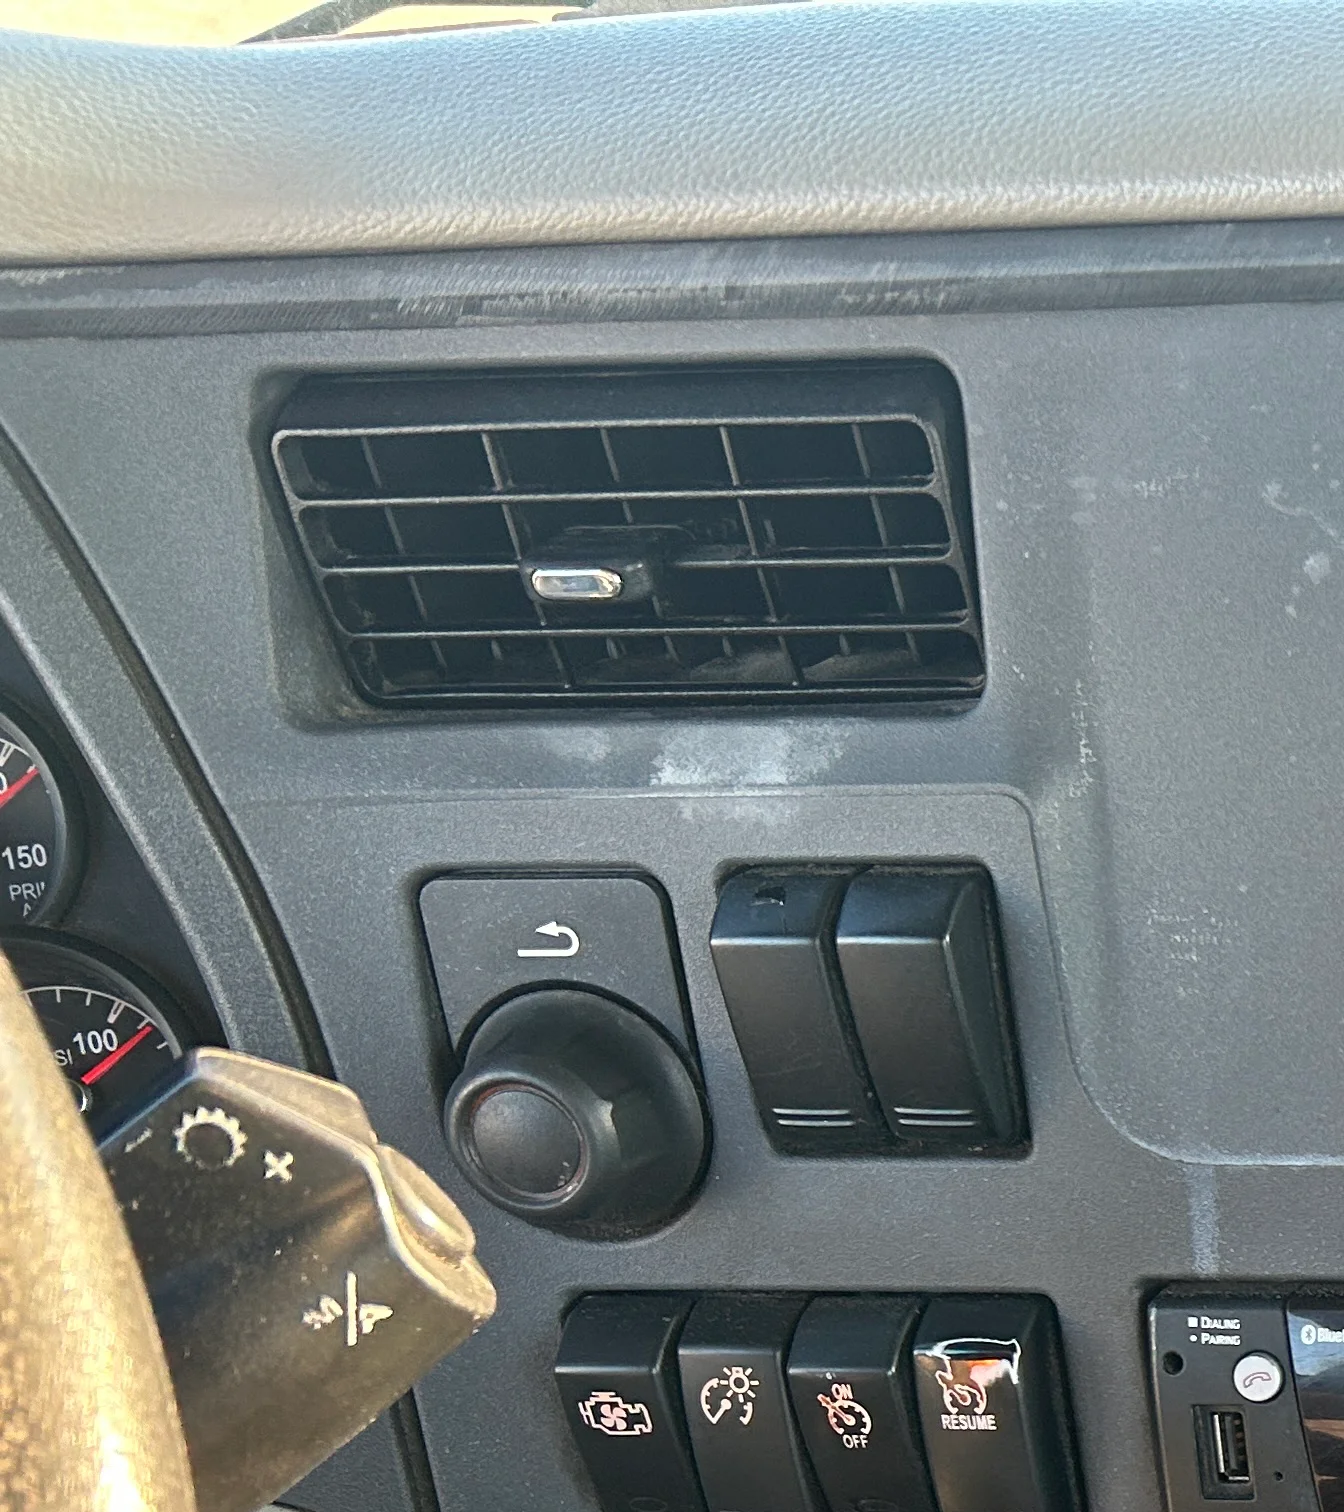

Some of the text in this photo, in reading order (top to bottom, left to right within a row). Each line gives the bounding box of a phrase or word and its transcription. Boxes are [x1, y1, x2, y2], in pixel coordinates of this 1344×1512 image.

[1, 843, 48, 871] 150
[9, 881, 45, 902] PRI
[72, 1027, 119, 1056] 100
[53, 1048, 74, 1067] SI
[1200, 1316, 1241, 1330] DIALING
[1200, 1332, 1241, 1346] PAIRING
[832, 1383, 854, 1401] ON
[941, 1413, 997, 1432] RESUME
[842, 1434, 869, 1449] OFF
